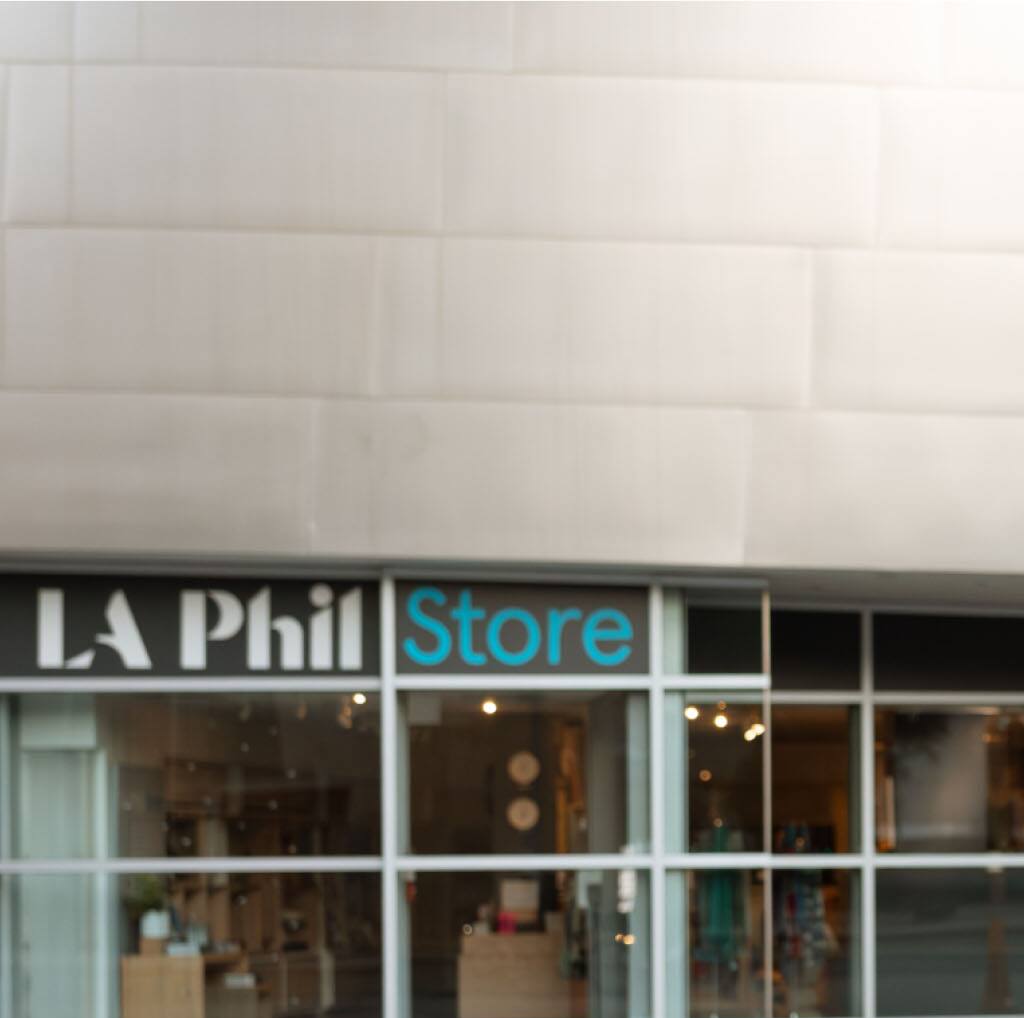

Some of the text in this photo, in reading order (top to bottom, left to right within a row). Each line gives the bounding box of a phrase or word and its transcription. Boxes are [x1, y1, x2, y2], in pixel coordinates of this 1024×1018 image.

[37, 583, 634, 670] LA Phil Store
